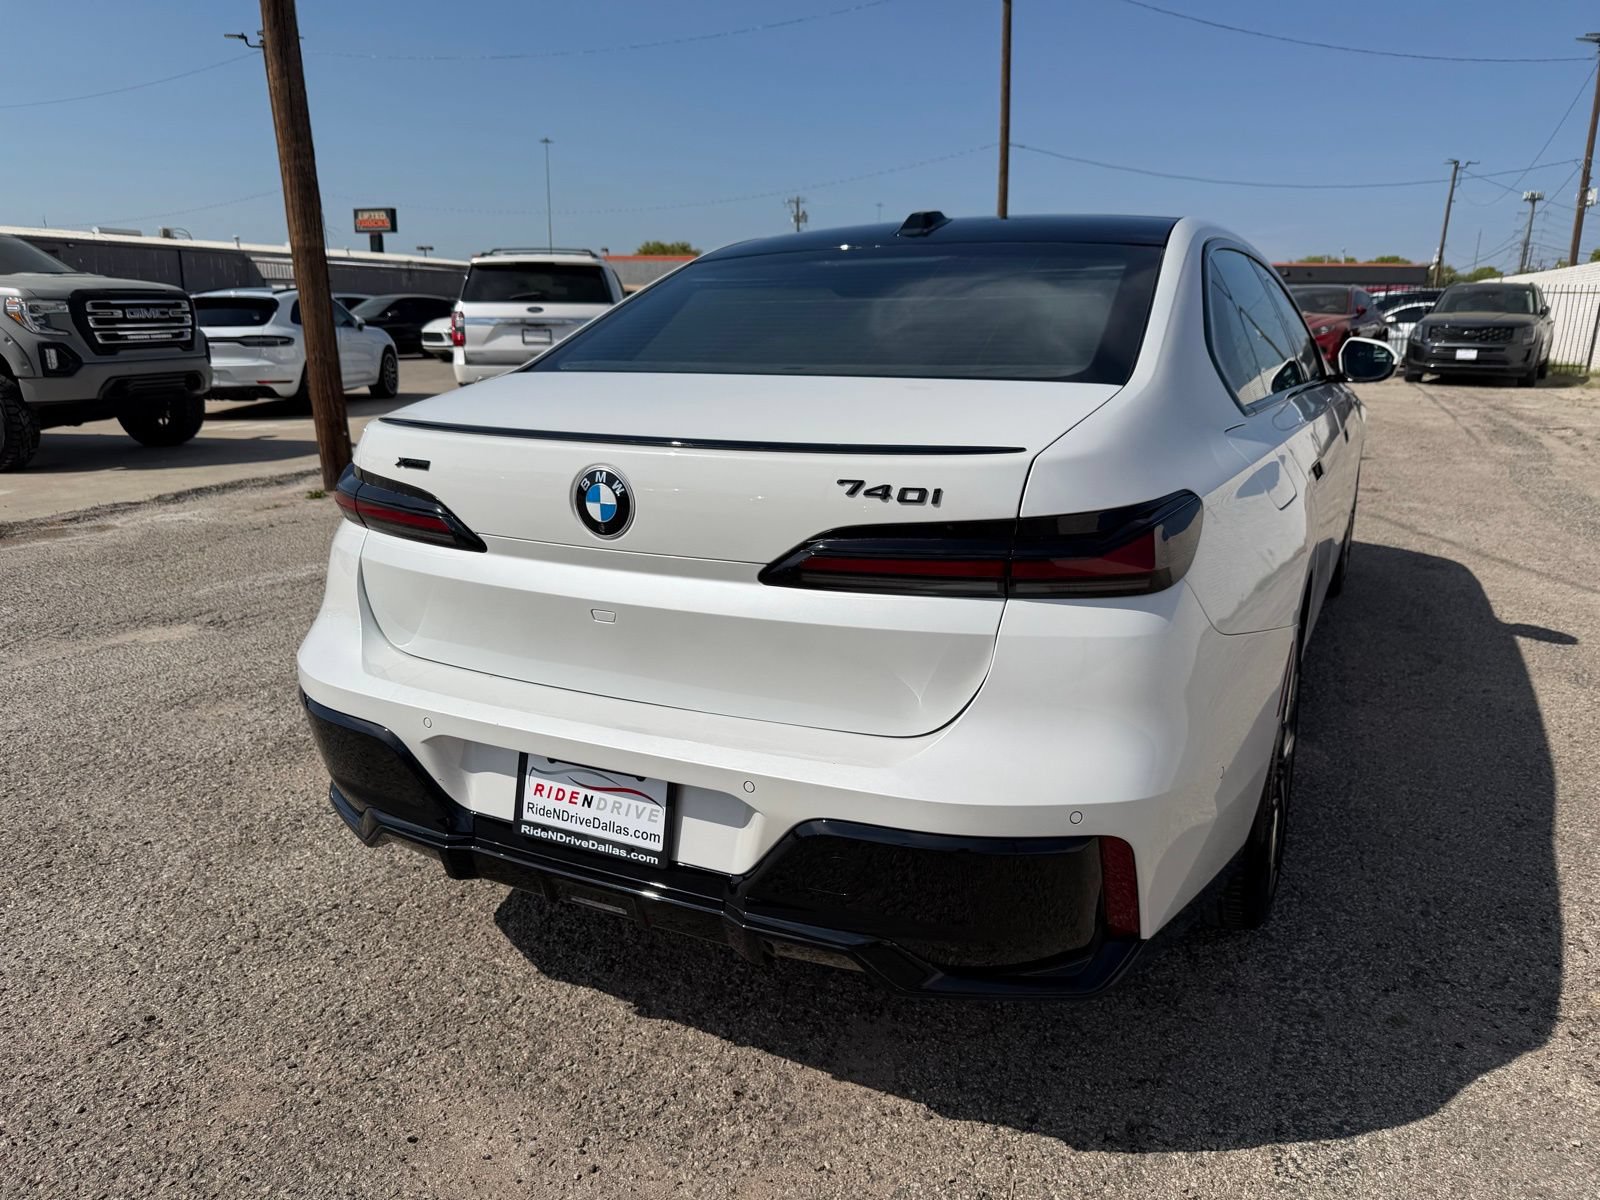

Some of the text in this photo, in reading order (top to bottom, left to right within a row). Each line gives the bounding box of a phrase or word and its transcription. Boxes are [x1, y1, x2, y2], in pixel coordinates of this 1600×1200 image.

[126, 308, 170, 319] GMC
[580, 471, 625, 497] BMW
[527, 802, 661, 844] RideNDriveDallas.com
[520, 824, 659, 865] RideNDriveDallas.com
